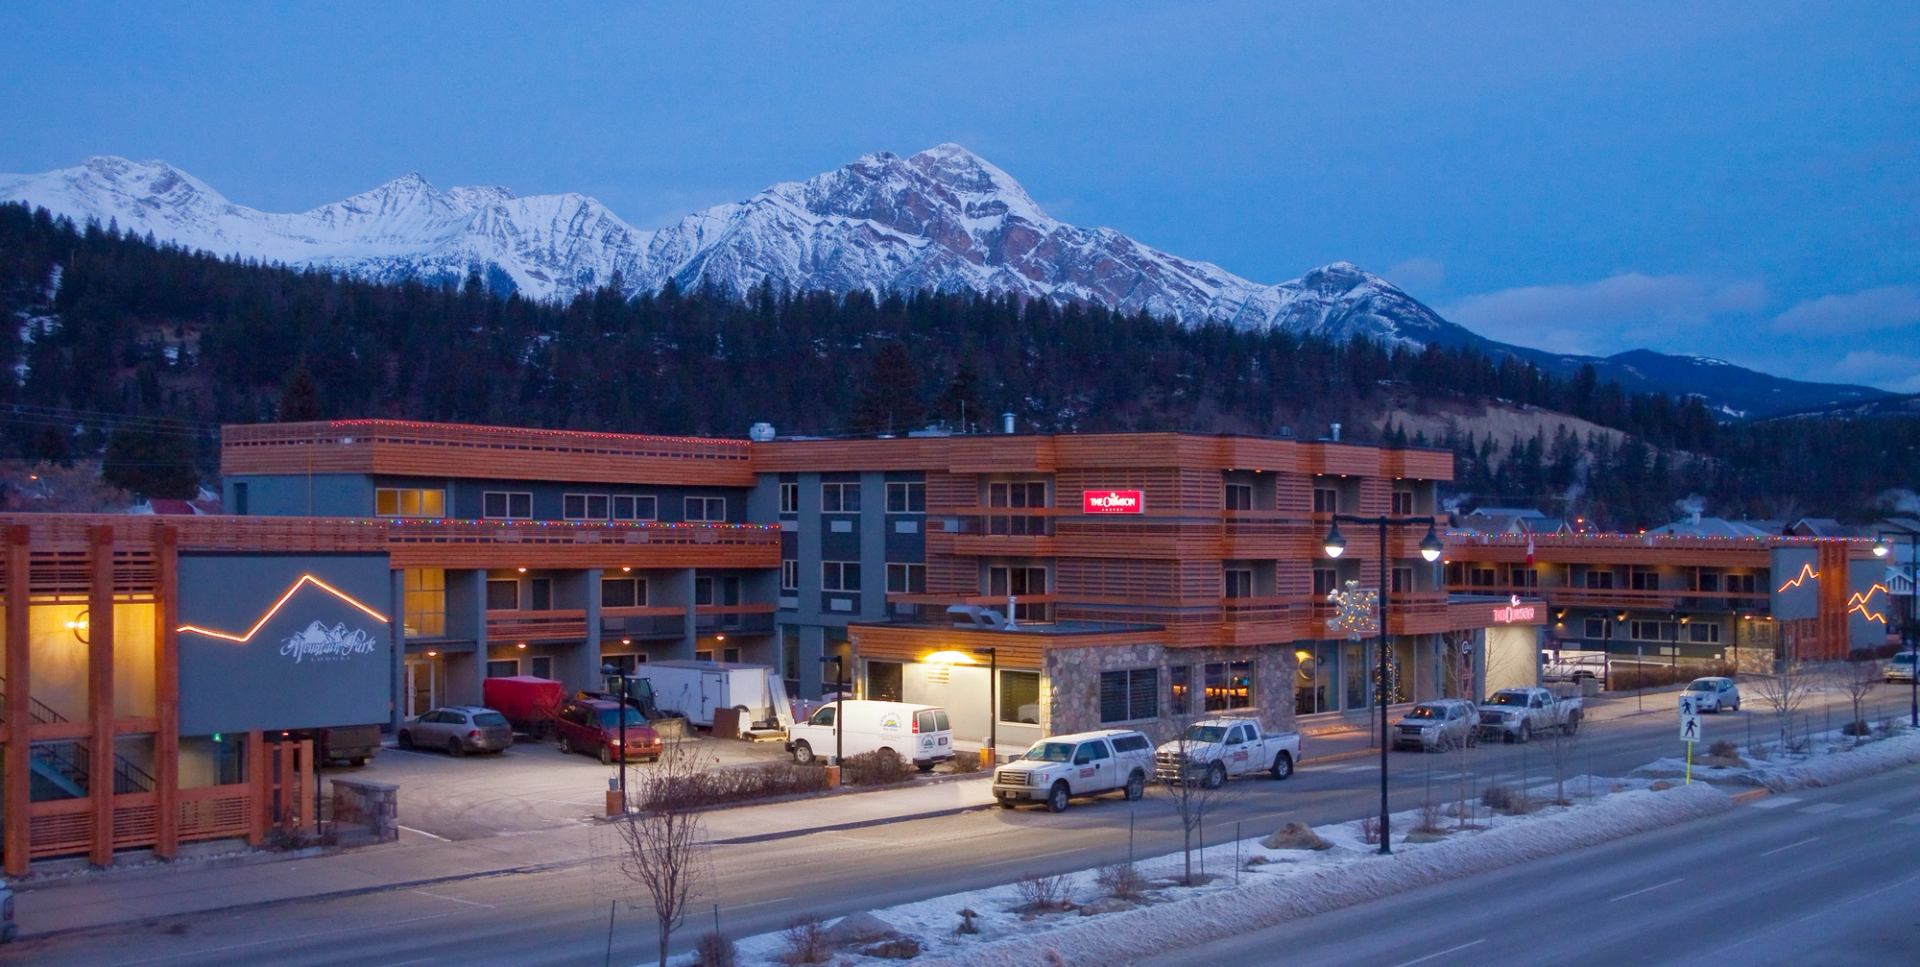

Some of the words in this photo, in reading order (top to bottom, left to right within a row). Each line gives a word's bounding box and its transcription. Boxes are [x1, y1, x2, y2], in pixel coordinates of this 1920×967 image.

[1090, 498, 1103, 506] THE
[280, 637, 341, 664] Mountain
[341, 628, 376, 656] Park
